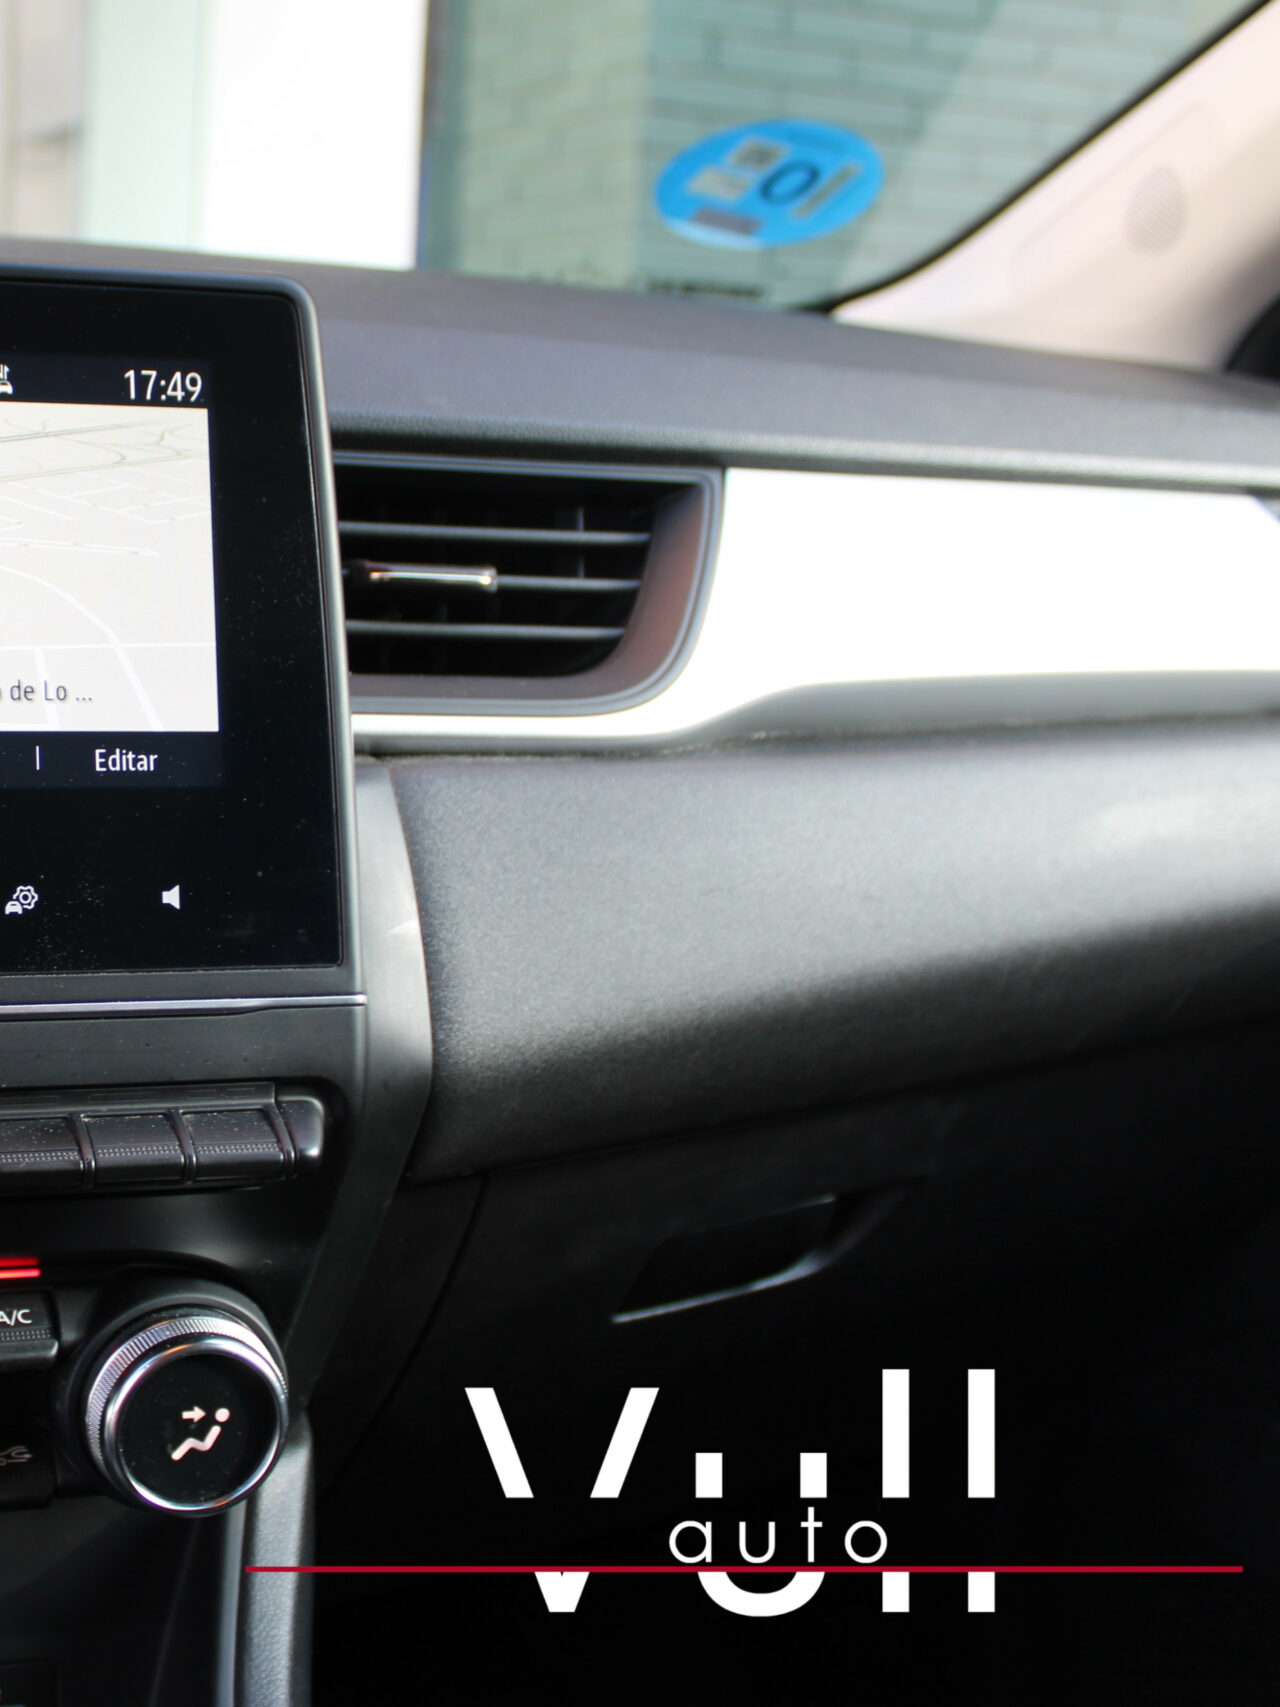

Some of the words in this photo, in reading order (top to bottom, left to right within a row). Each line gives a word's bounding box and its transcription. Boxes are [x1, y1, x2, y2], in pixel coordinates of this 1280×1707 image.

[123, 368, 203, 403] 17:49
[9, 679, 35, 701] de
[43, 680, 68, 701] Lo
[94, 748, 159, 771] Editar
